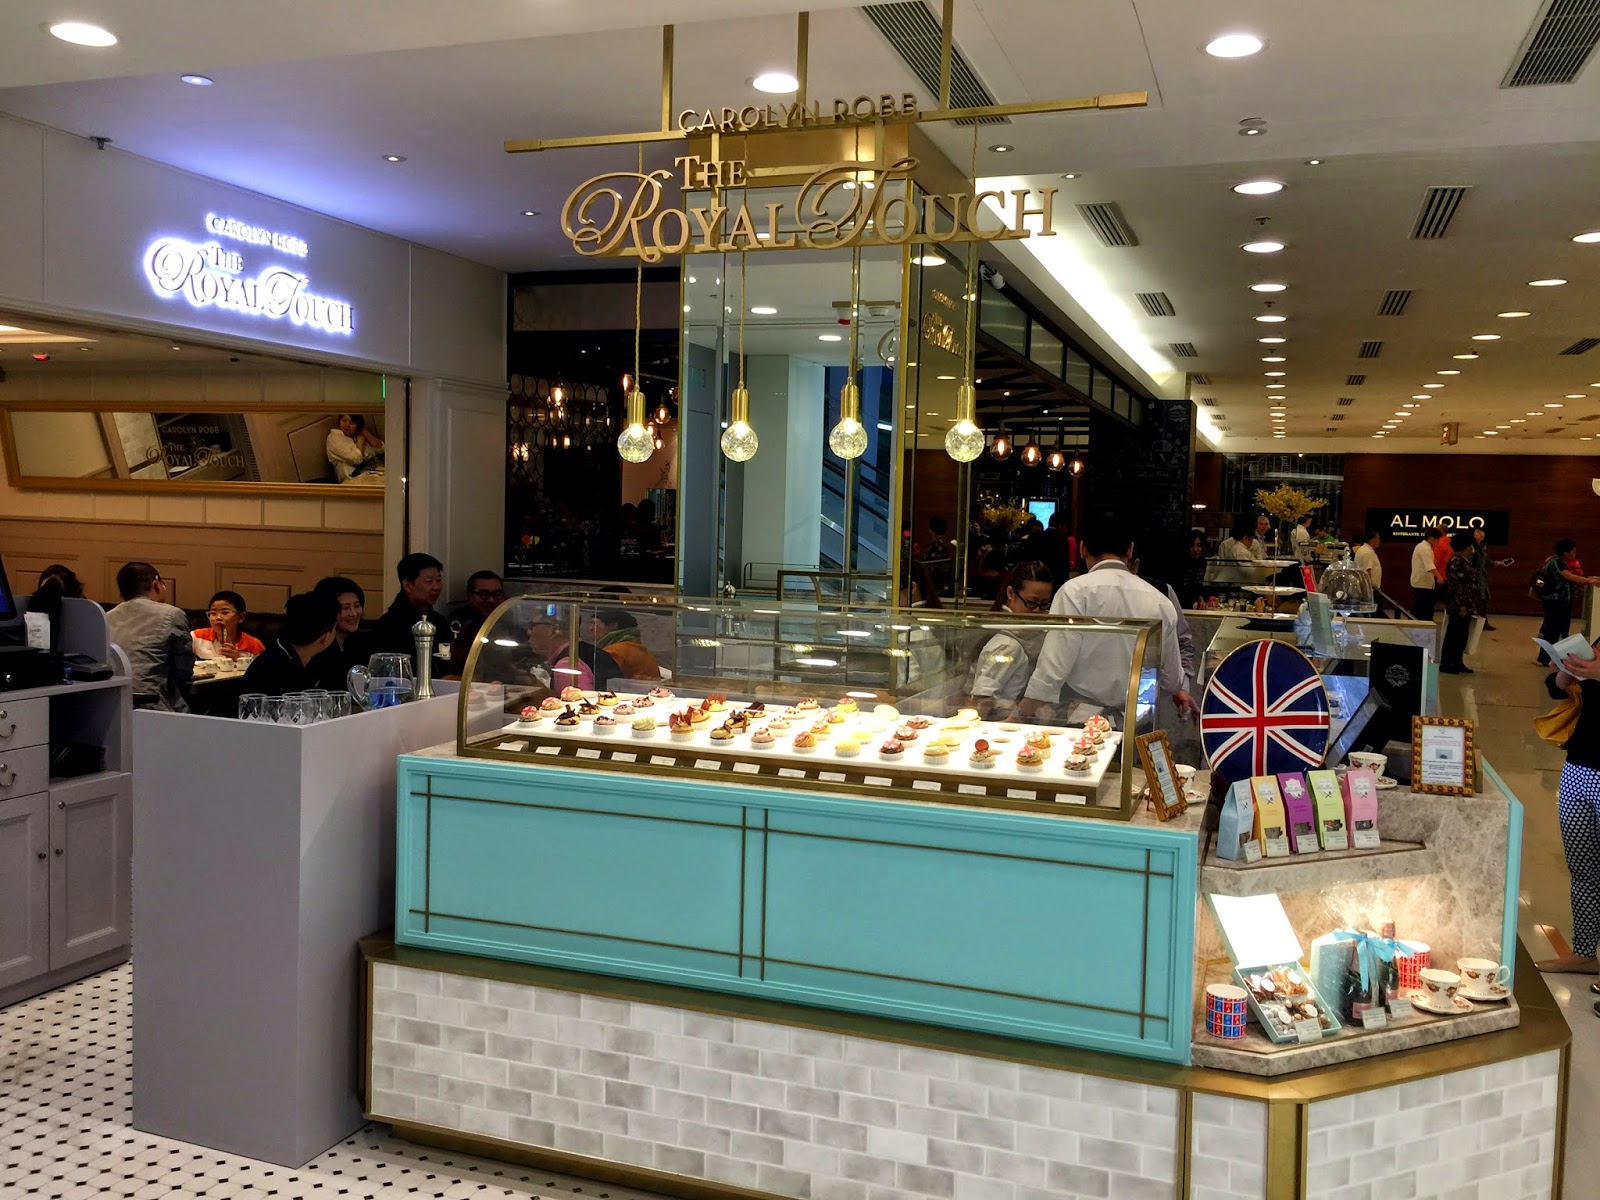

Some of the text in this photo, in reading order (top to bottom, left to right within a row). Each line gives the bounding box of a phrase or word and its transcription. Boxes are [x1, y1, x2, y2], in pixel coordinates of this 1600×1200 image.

[678, 92, 919, 134] CAROLYN ROBB
[674, 155, 748, 190] THE
[560, 157, 1060, 263] ROYAL TOUCH
[210, 216, 274, 246] CAROLYN
[211, 245, 245, 272] THE
[151, 242, 355, 331] ROYAL TOUCH
[1390, 514, 1485, 530] AL MOLO
